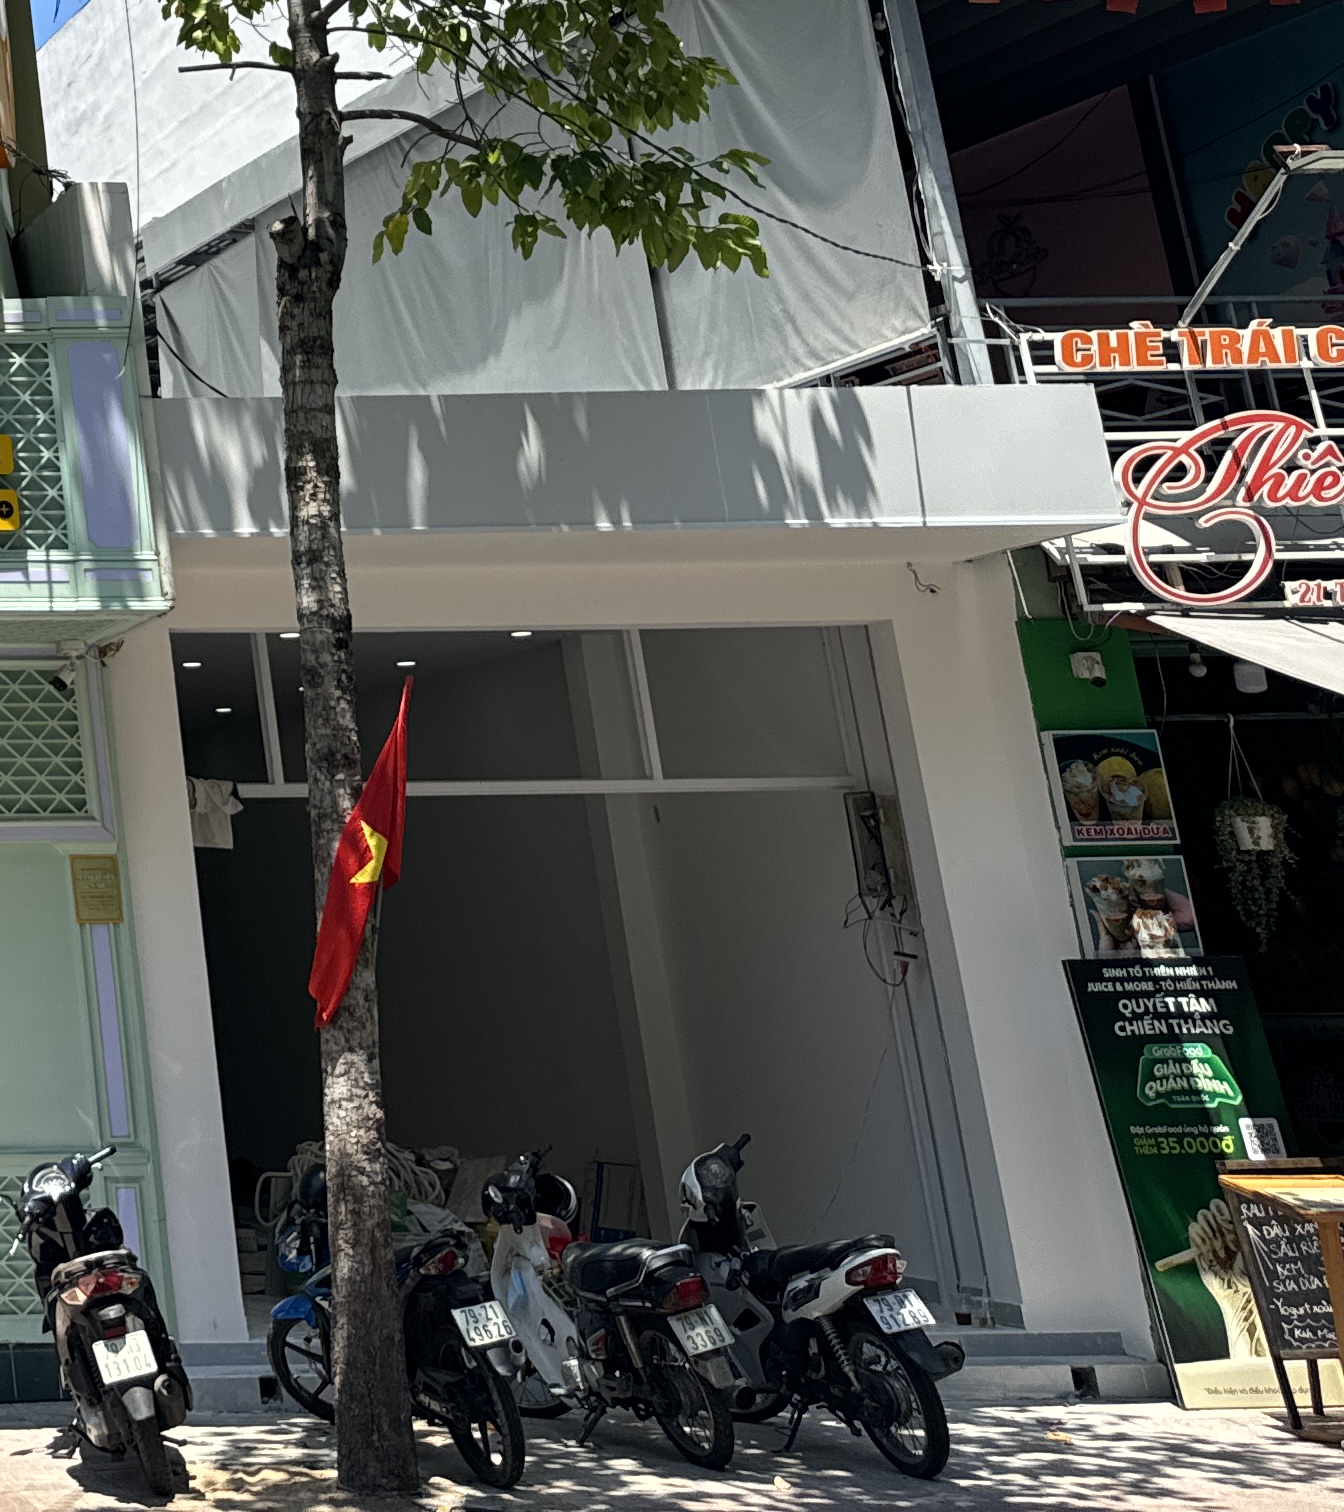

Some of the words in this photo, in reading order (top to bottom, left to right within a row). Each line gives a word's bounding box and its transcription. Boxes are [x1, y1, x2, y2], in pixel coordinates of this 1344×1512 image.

[1058, 321, 1166, 369] CHÈ
[1175, 319, 1299, 368] TRÁI
[1298, 582, 1322, 603] 21
[1076, 826, 1104, 837] KEM
[1102, 967, 1127, 978] SINH
[1128, 965, 1142, 977] TỐ
[1087, 982, 1113, 992] JUICE
[1116, 982, 1123, 992] &
[1124, 981, 1155, 991] MORE
[1160, 980, 1175, 991] TÔ
[1201, 978, 1238, 990] THÀNH
[1118, 992, 1175, 1018] QUYẾT
[1177, 993, 1218, 1013] TÂM
[1114, 1014, 1168, 1036] CHIẾN
[1168, 1012, 1234, 1035] THẮNG
[1152, 1045, 1204, 1057] GrabFood
[1144, 1075, 1189, 1099] QUÁN
[1160, 1135, 1234, 1155] 35.000đ
[687, 1327, 725, 1351] 3369
